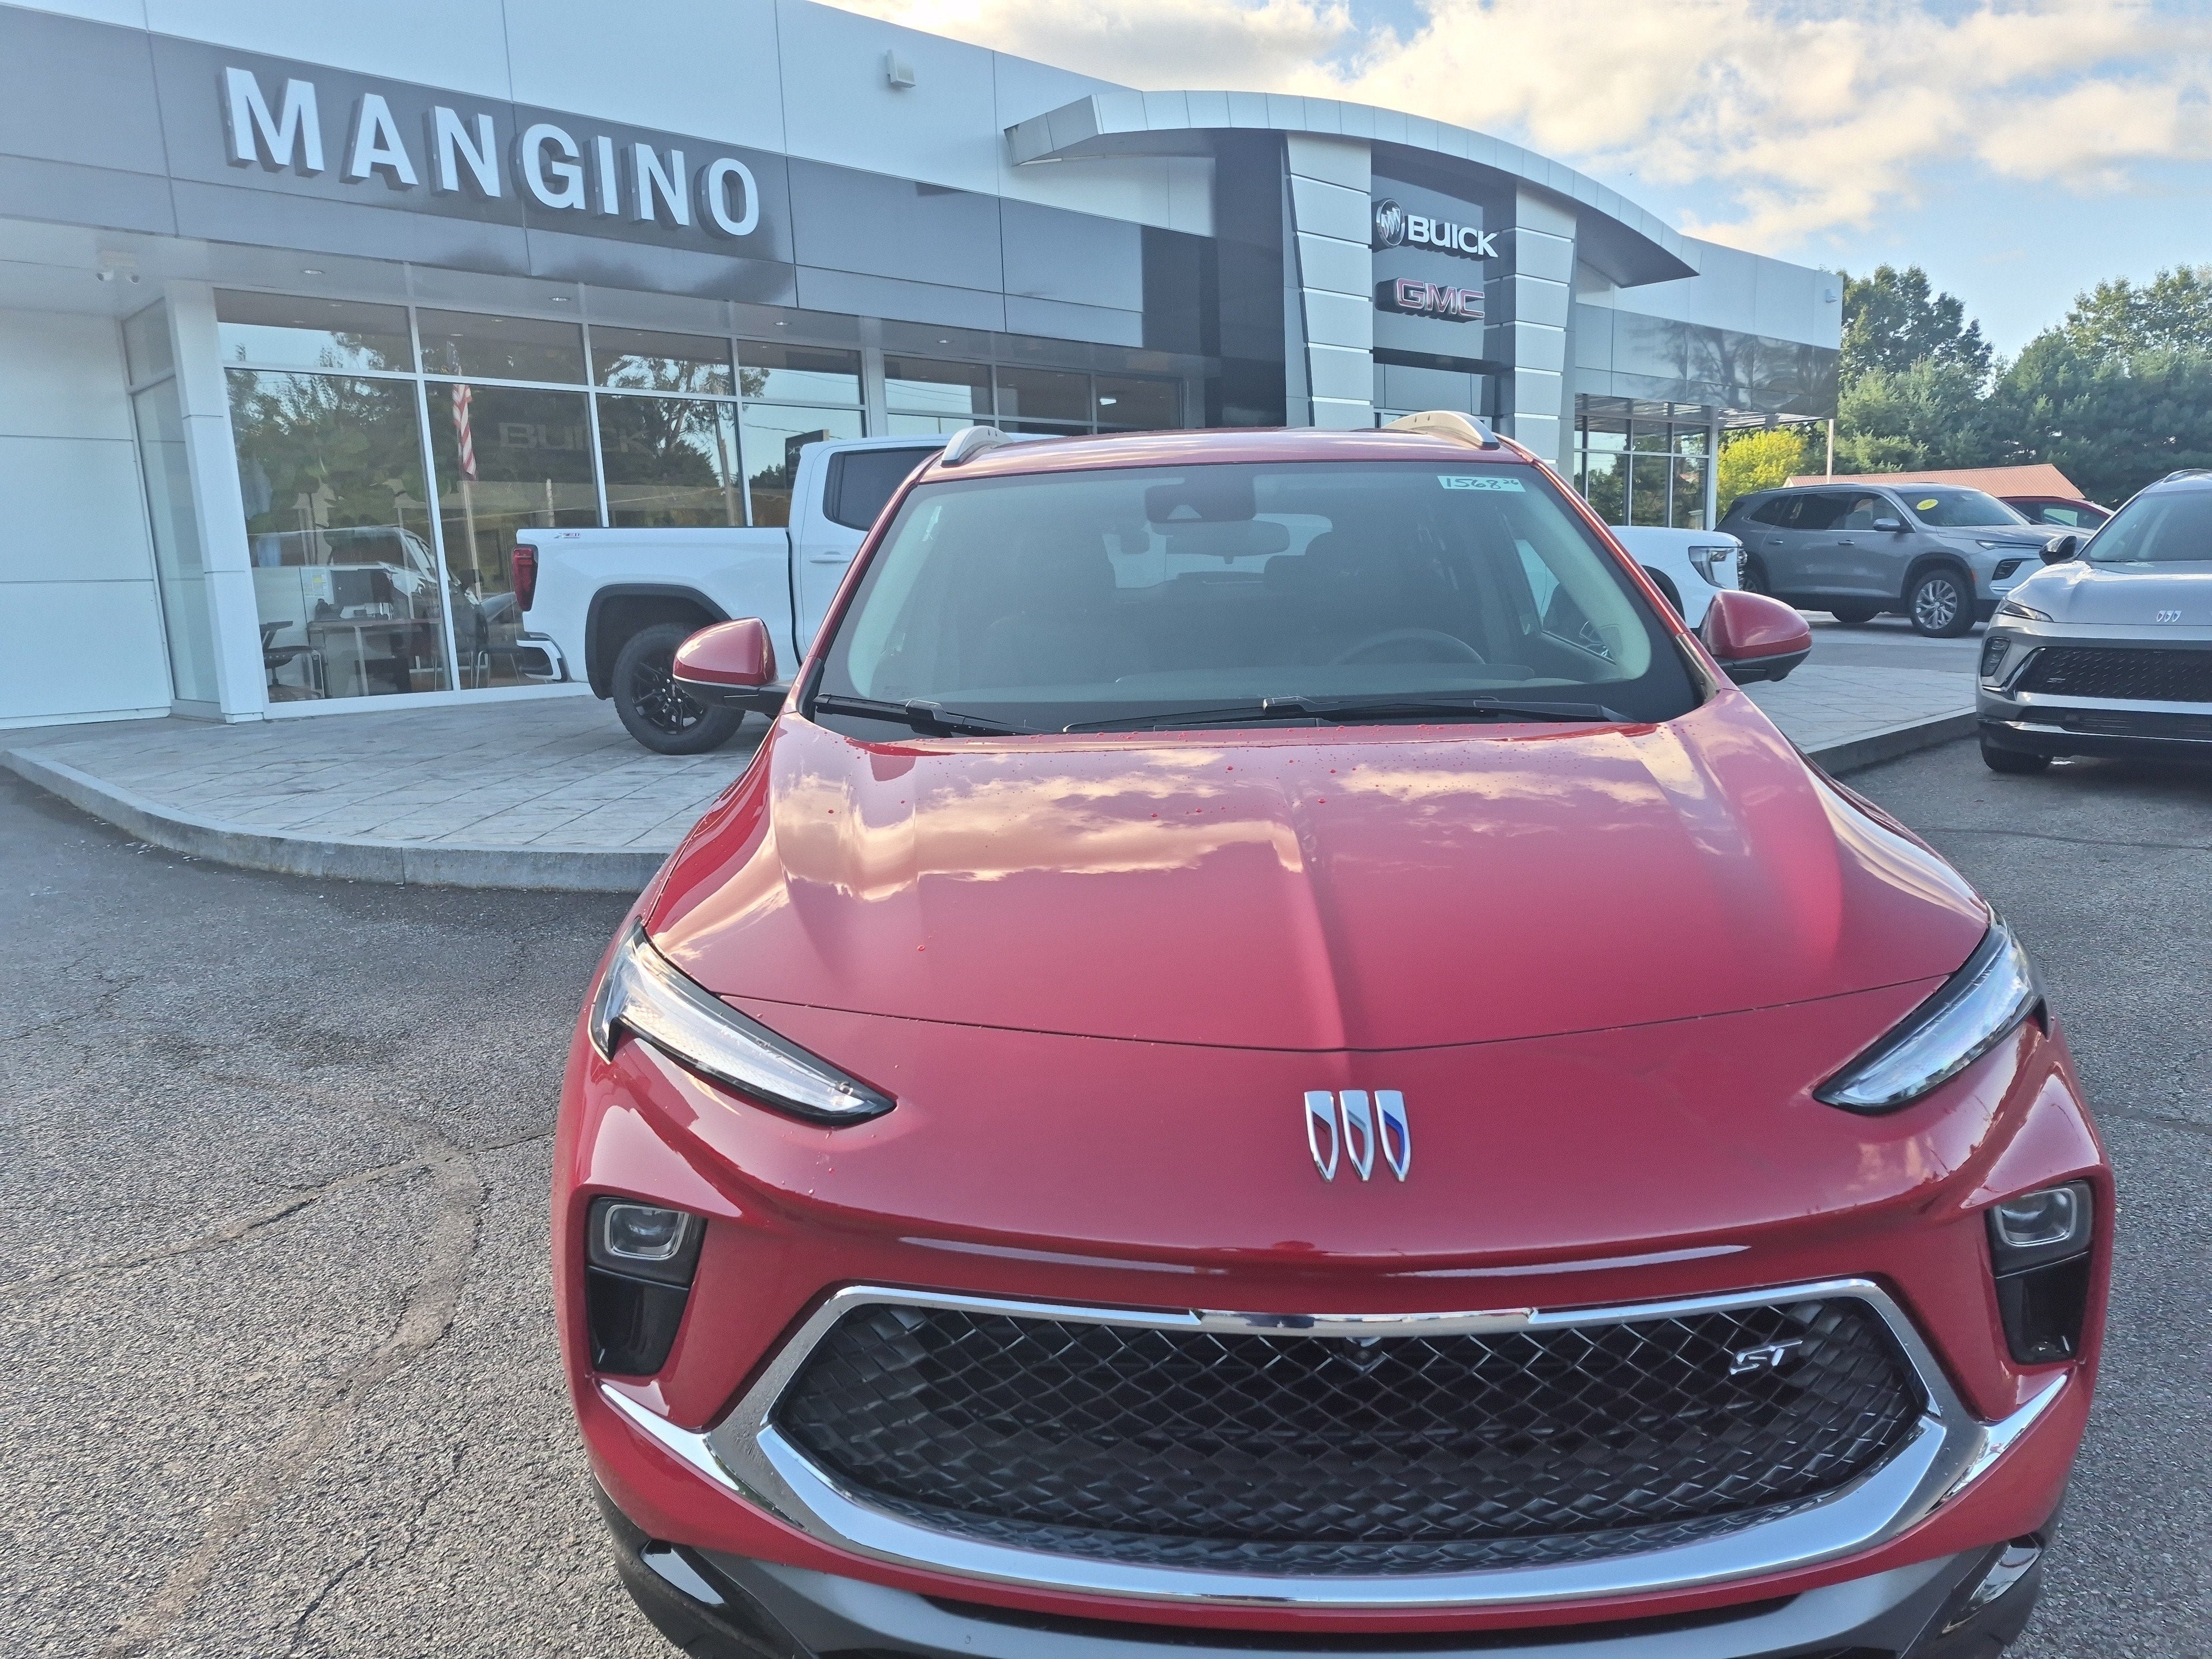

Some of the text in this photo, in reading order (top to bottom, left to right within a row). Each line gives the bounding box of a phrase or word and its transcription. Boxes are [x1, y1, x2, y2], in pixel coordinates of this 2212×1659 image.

[225, 66, 759, 236] MANGINO
[1407, 214, 1499, 258] BUICK
[1397, 277, 1486, 319] GMC
[1446, 478, 1501, 490] 1568
[1729, 1340, 1803, 1375] ST
